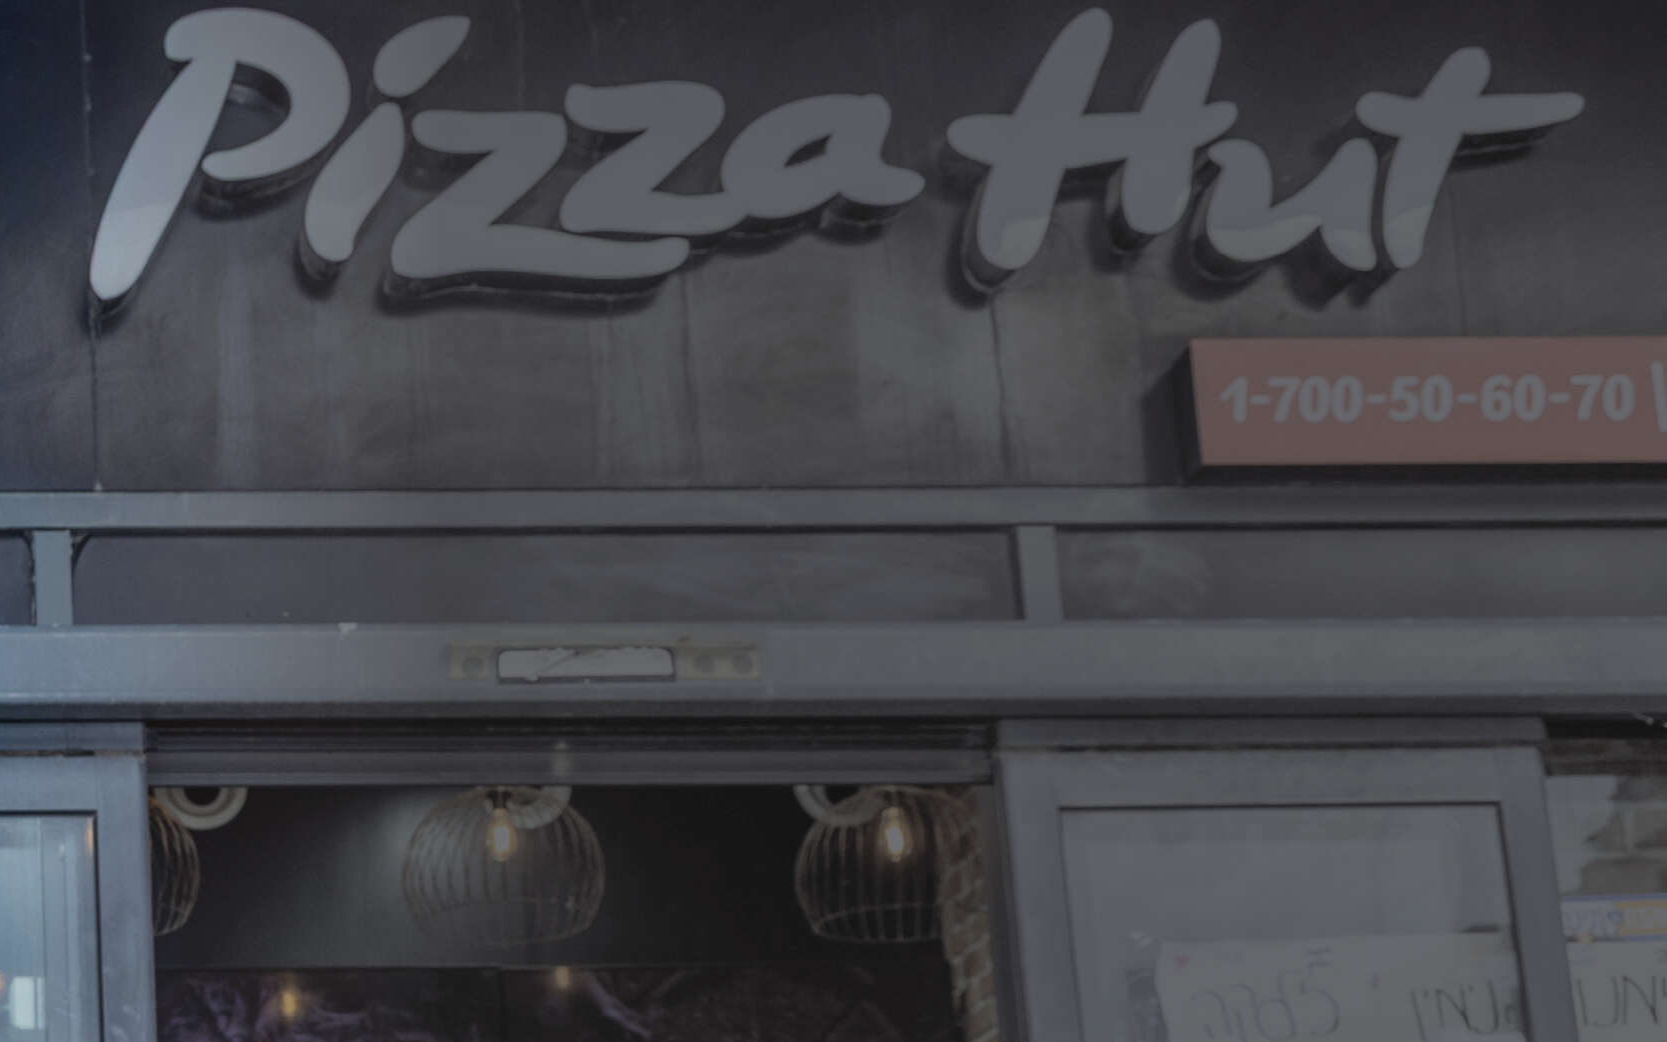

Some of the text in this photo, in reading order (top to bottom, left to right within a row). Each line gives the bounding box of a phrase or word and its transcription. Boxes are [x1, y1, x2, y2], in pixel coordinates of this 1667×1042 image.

[89, 7, 1584, 301] Pizza Hut
[1220, 374, 1633, 423] 1-700-50-60-70
